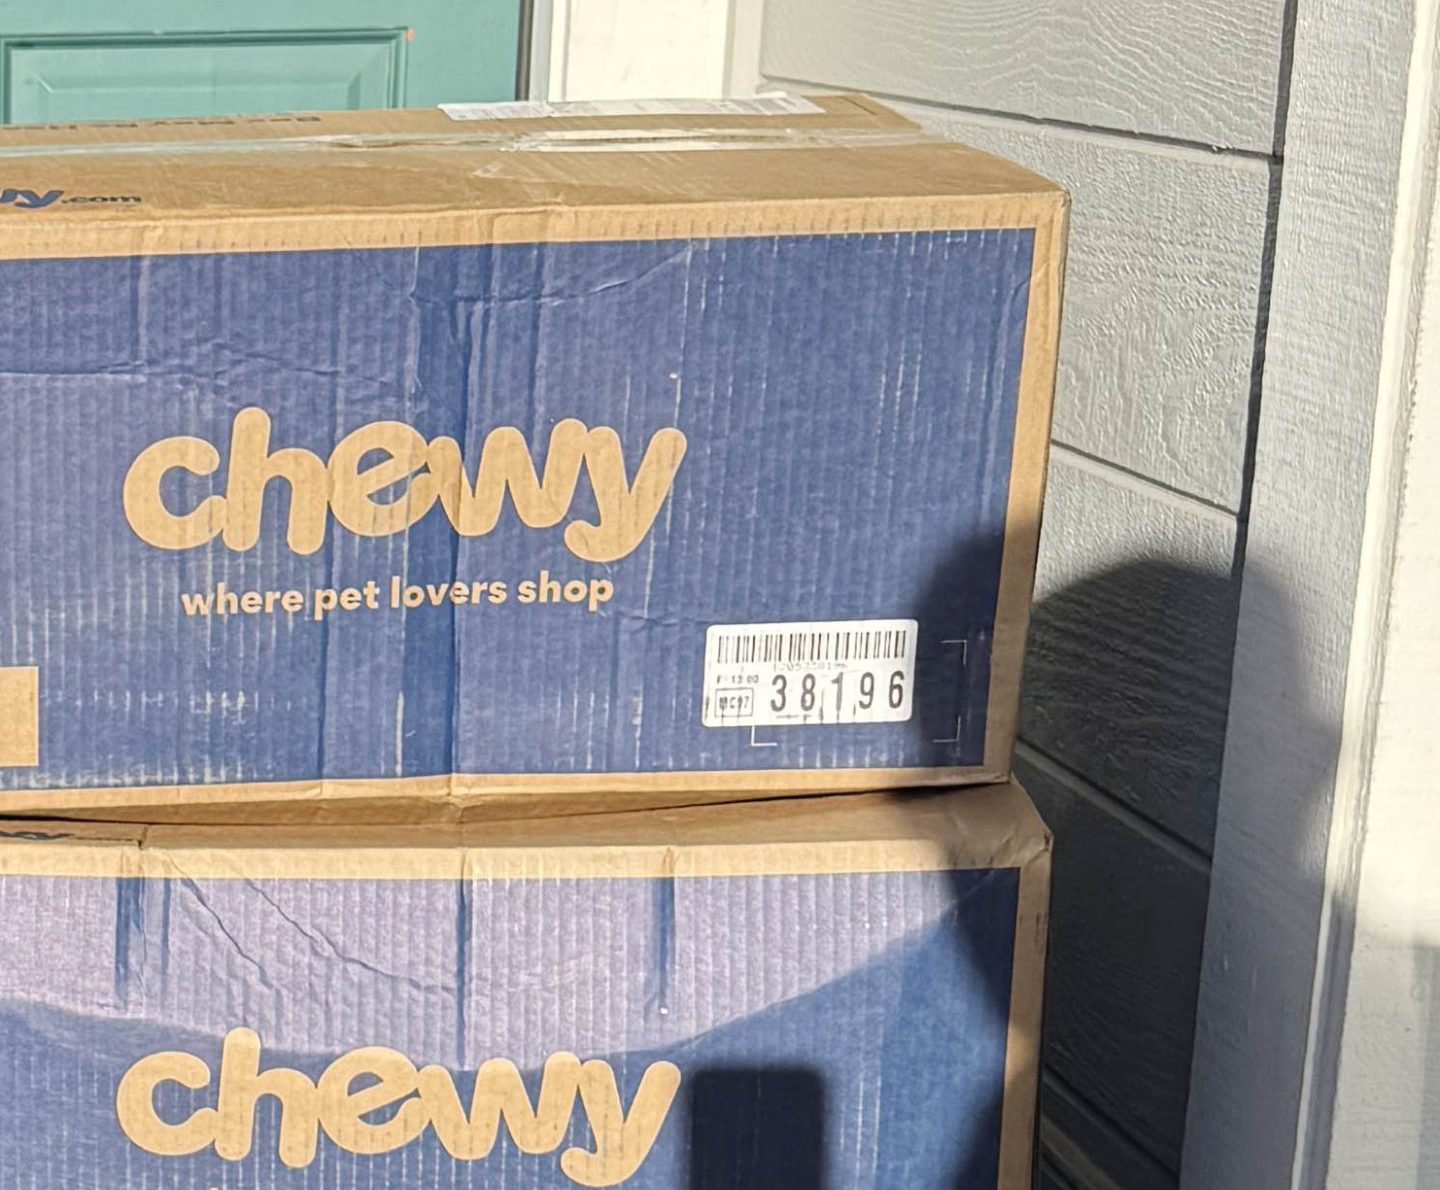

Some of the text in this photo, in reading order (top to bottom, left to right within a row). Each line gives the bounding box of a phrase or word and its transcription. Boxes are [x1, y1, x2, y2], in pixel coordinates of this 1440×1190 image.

[122, 407, 687, 563] chewy
[181, 570, 615, 620] where pet lovers shop
[770, 670, 905, 712] 38196
[116, 1028, 682, 1187] chewy
